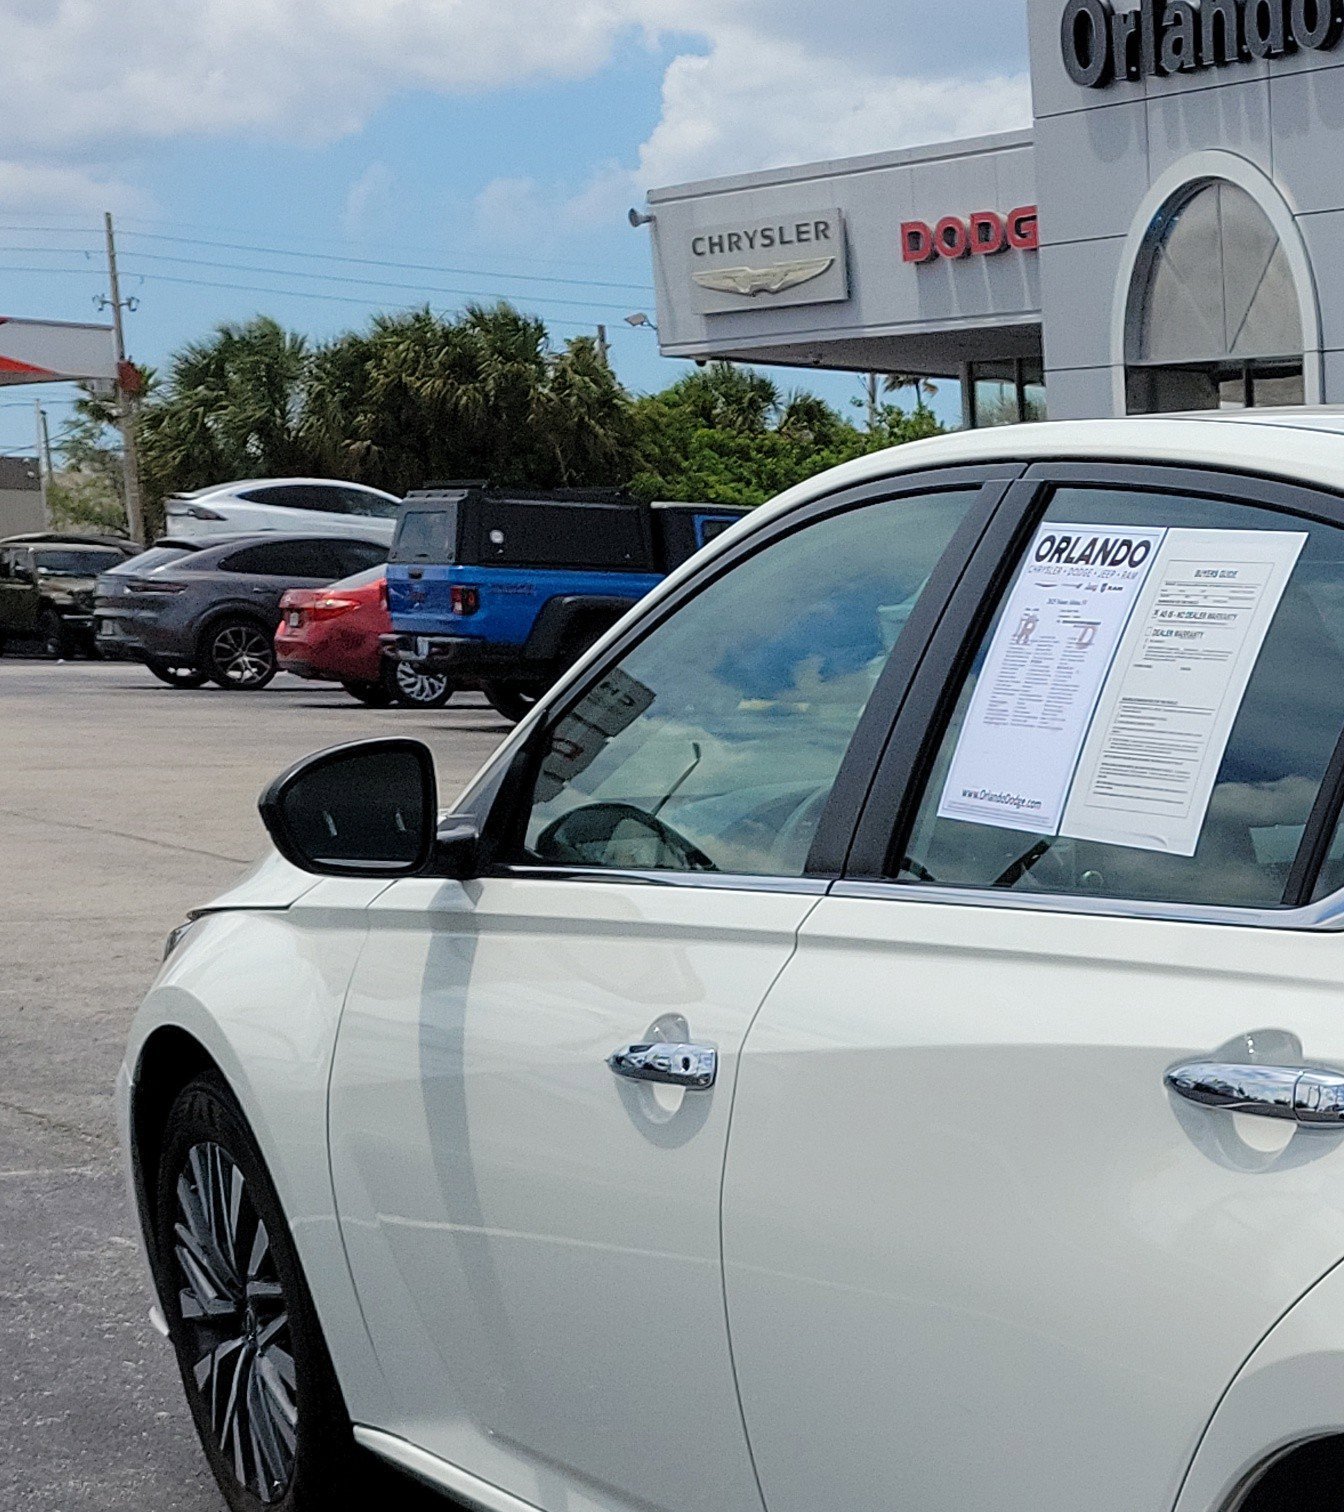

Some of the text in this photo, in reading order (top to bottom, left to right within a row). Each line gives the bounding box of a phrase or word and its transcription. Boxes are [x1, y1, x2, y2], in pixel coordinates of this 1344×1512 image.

[1060, 0, 1334, 87] Orlando
[692, 220, 831, 256] CHRYSLER
[1035, 534, 1151, 568] ORLANDO
